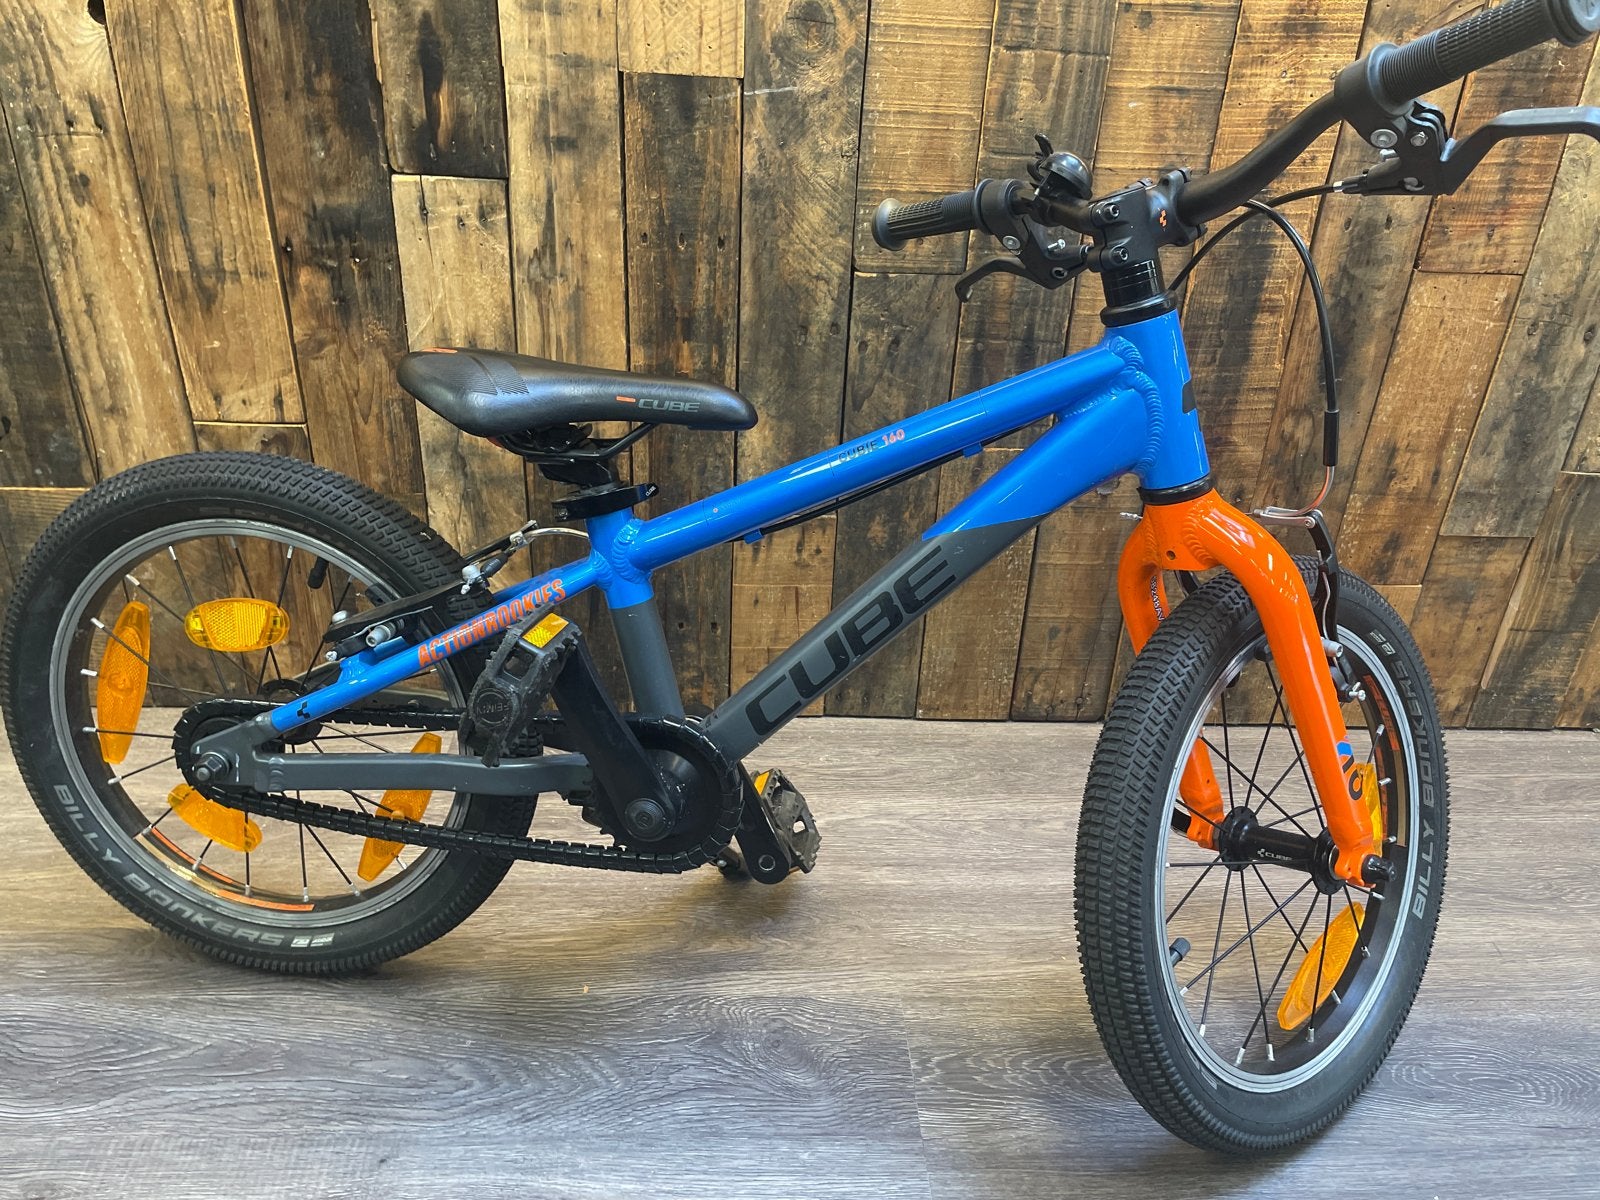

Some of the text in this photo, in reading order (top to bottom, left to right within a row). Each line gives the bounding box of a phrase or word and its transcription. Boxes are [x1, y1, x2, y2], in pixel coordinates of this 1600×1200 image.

[638, 397, 701, 413] CUBE
[838, 428, 906, 463] CUBIE 160
[417, 578, 567, 669] ACTIONROOKIES
[745, 544, 957, 736] CUBE
[1391, 660, 1436, 920] BILLY BONKERS
[52, 784, 286, 947] BILLY BONKERS
